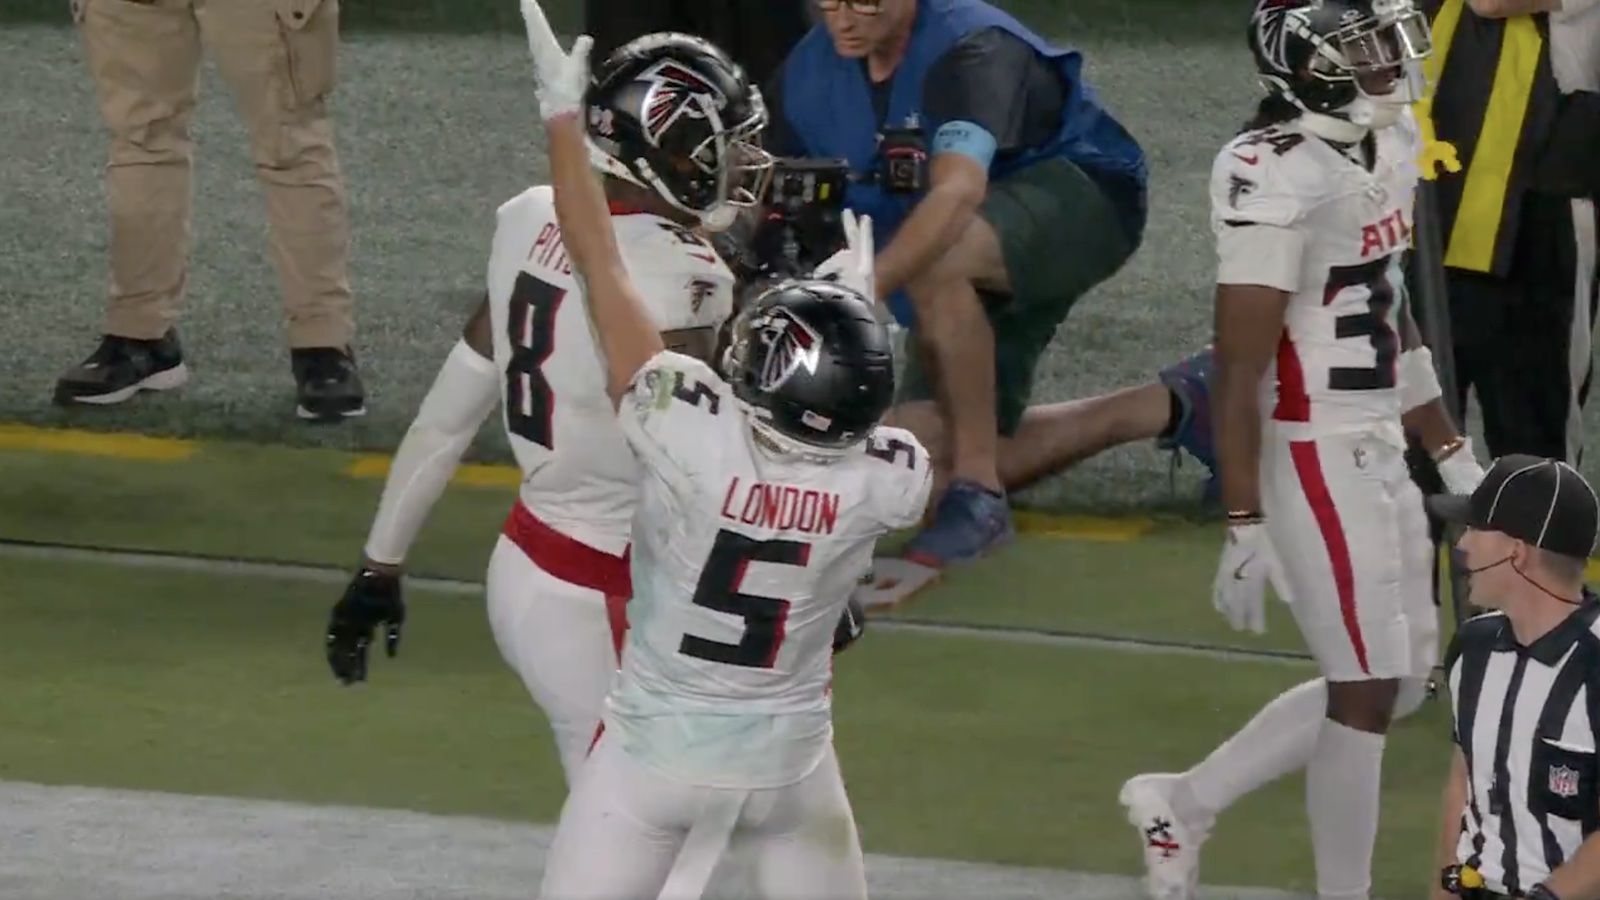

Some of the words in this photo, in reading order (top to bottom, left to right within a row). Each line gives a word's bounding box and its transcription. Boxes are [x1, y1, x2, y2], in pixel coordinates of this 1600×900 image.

[505, 270, 568, 451] 8
[671, 370, 721, 416] 5
[865, 437, 917, 471] 5
[719, 475, 841, 535] LONDON
[677, 528, 812, 669] 5
